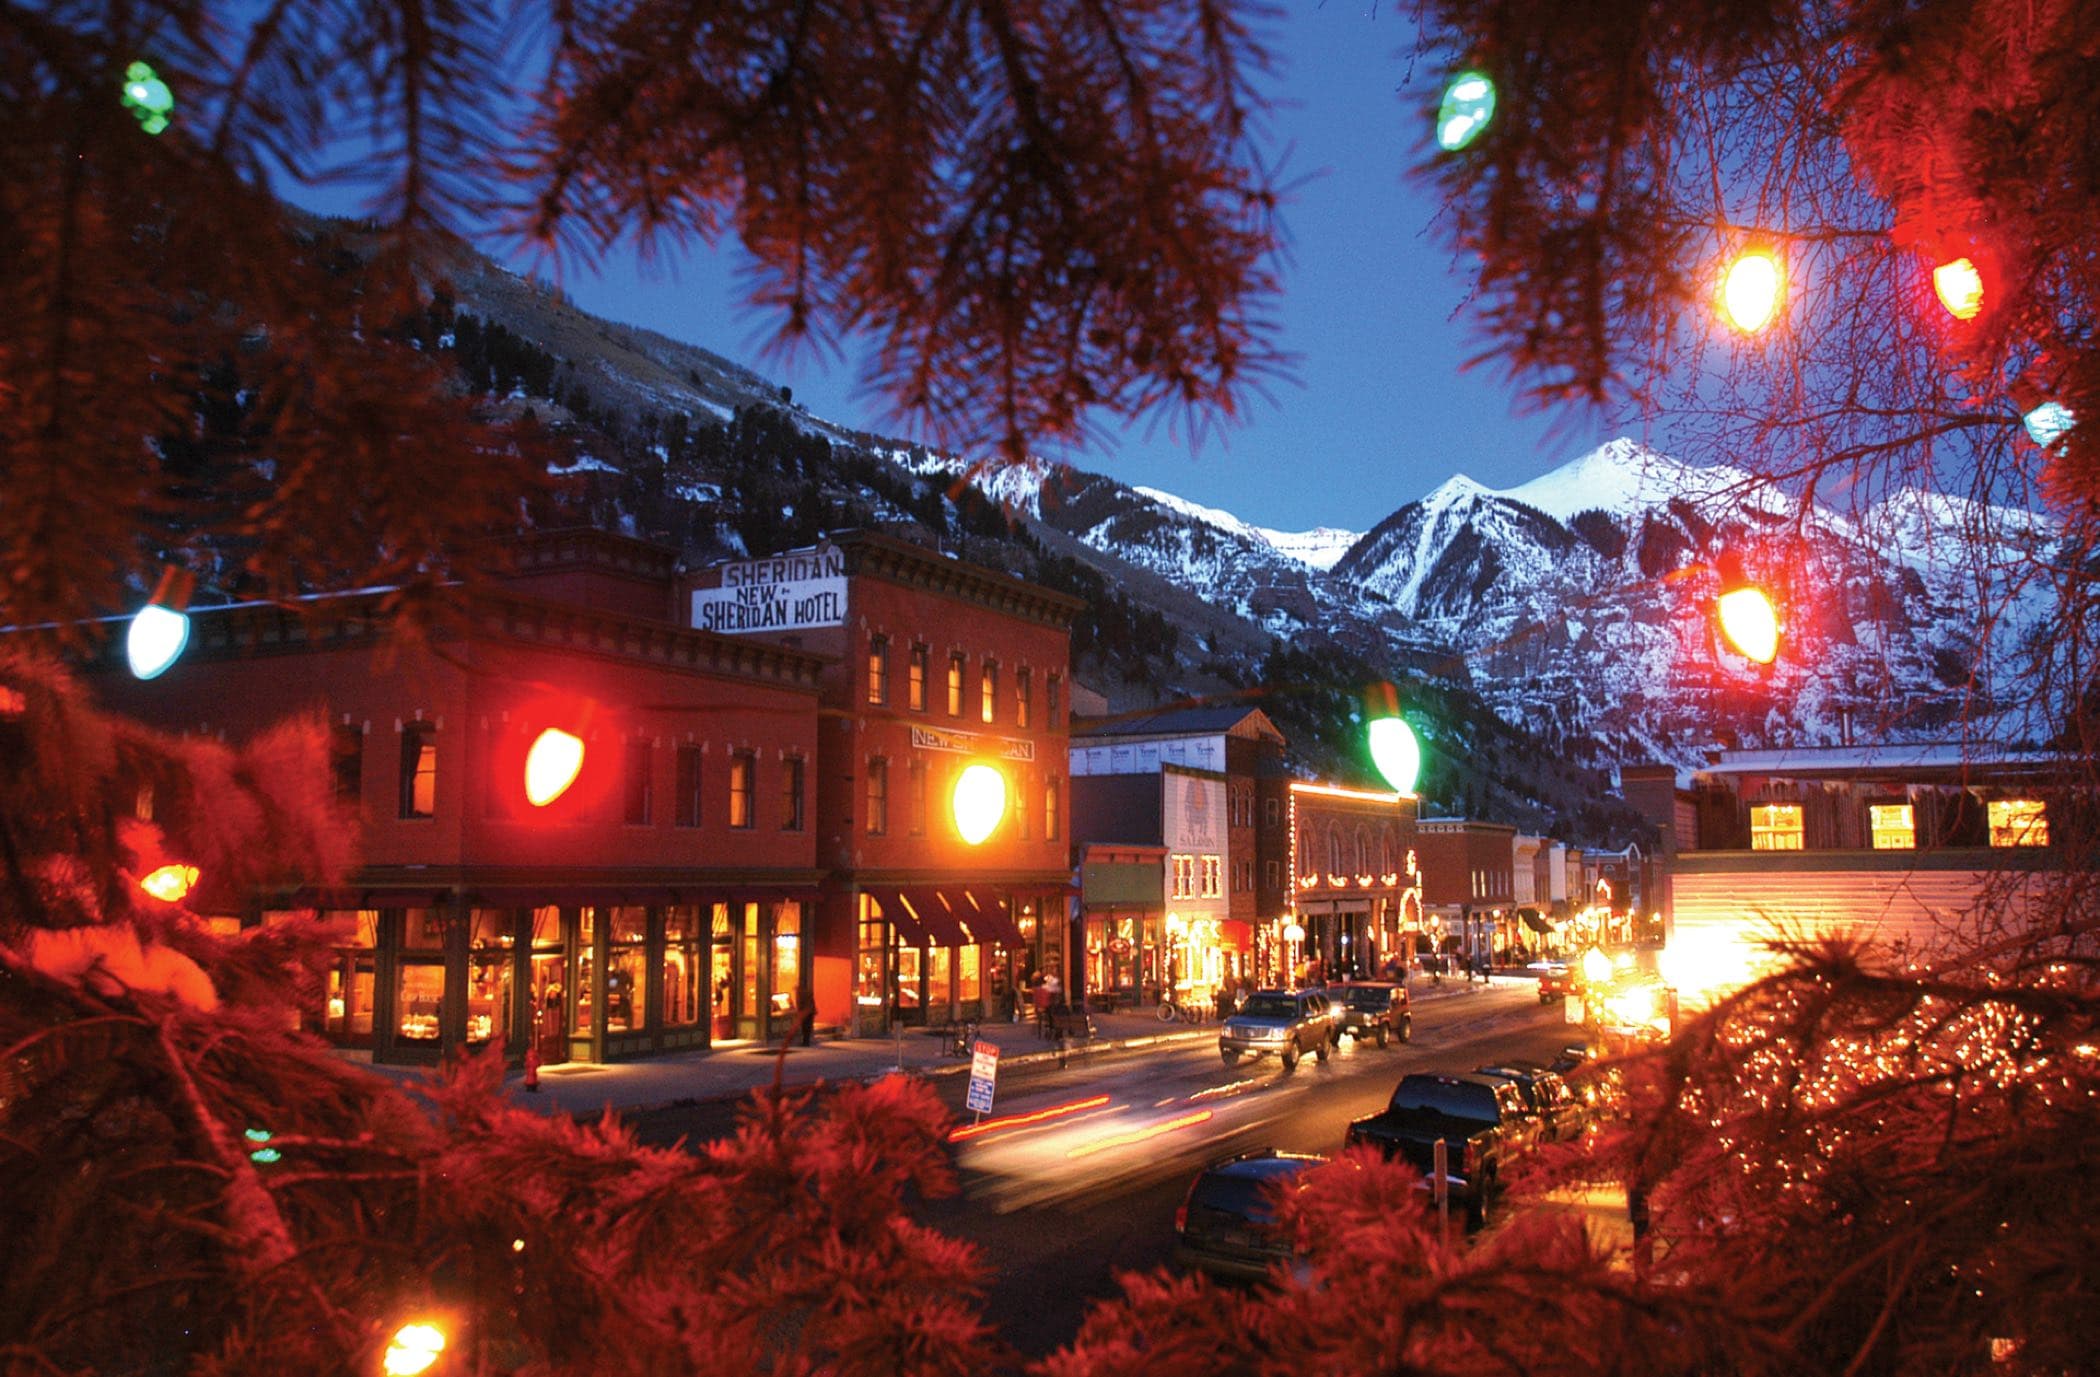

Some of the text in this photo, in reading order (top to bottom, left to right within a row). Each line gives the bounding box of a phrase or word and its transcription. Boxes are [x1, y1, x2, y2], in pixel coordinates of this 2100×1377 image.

[726, 555, 840, 587] SHERIDAN
[736, 585, 778, 605] NEW
[702, 592, 841, 631] SHERIDAN HOTEL
[914, 728, 948, 748] NEW
